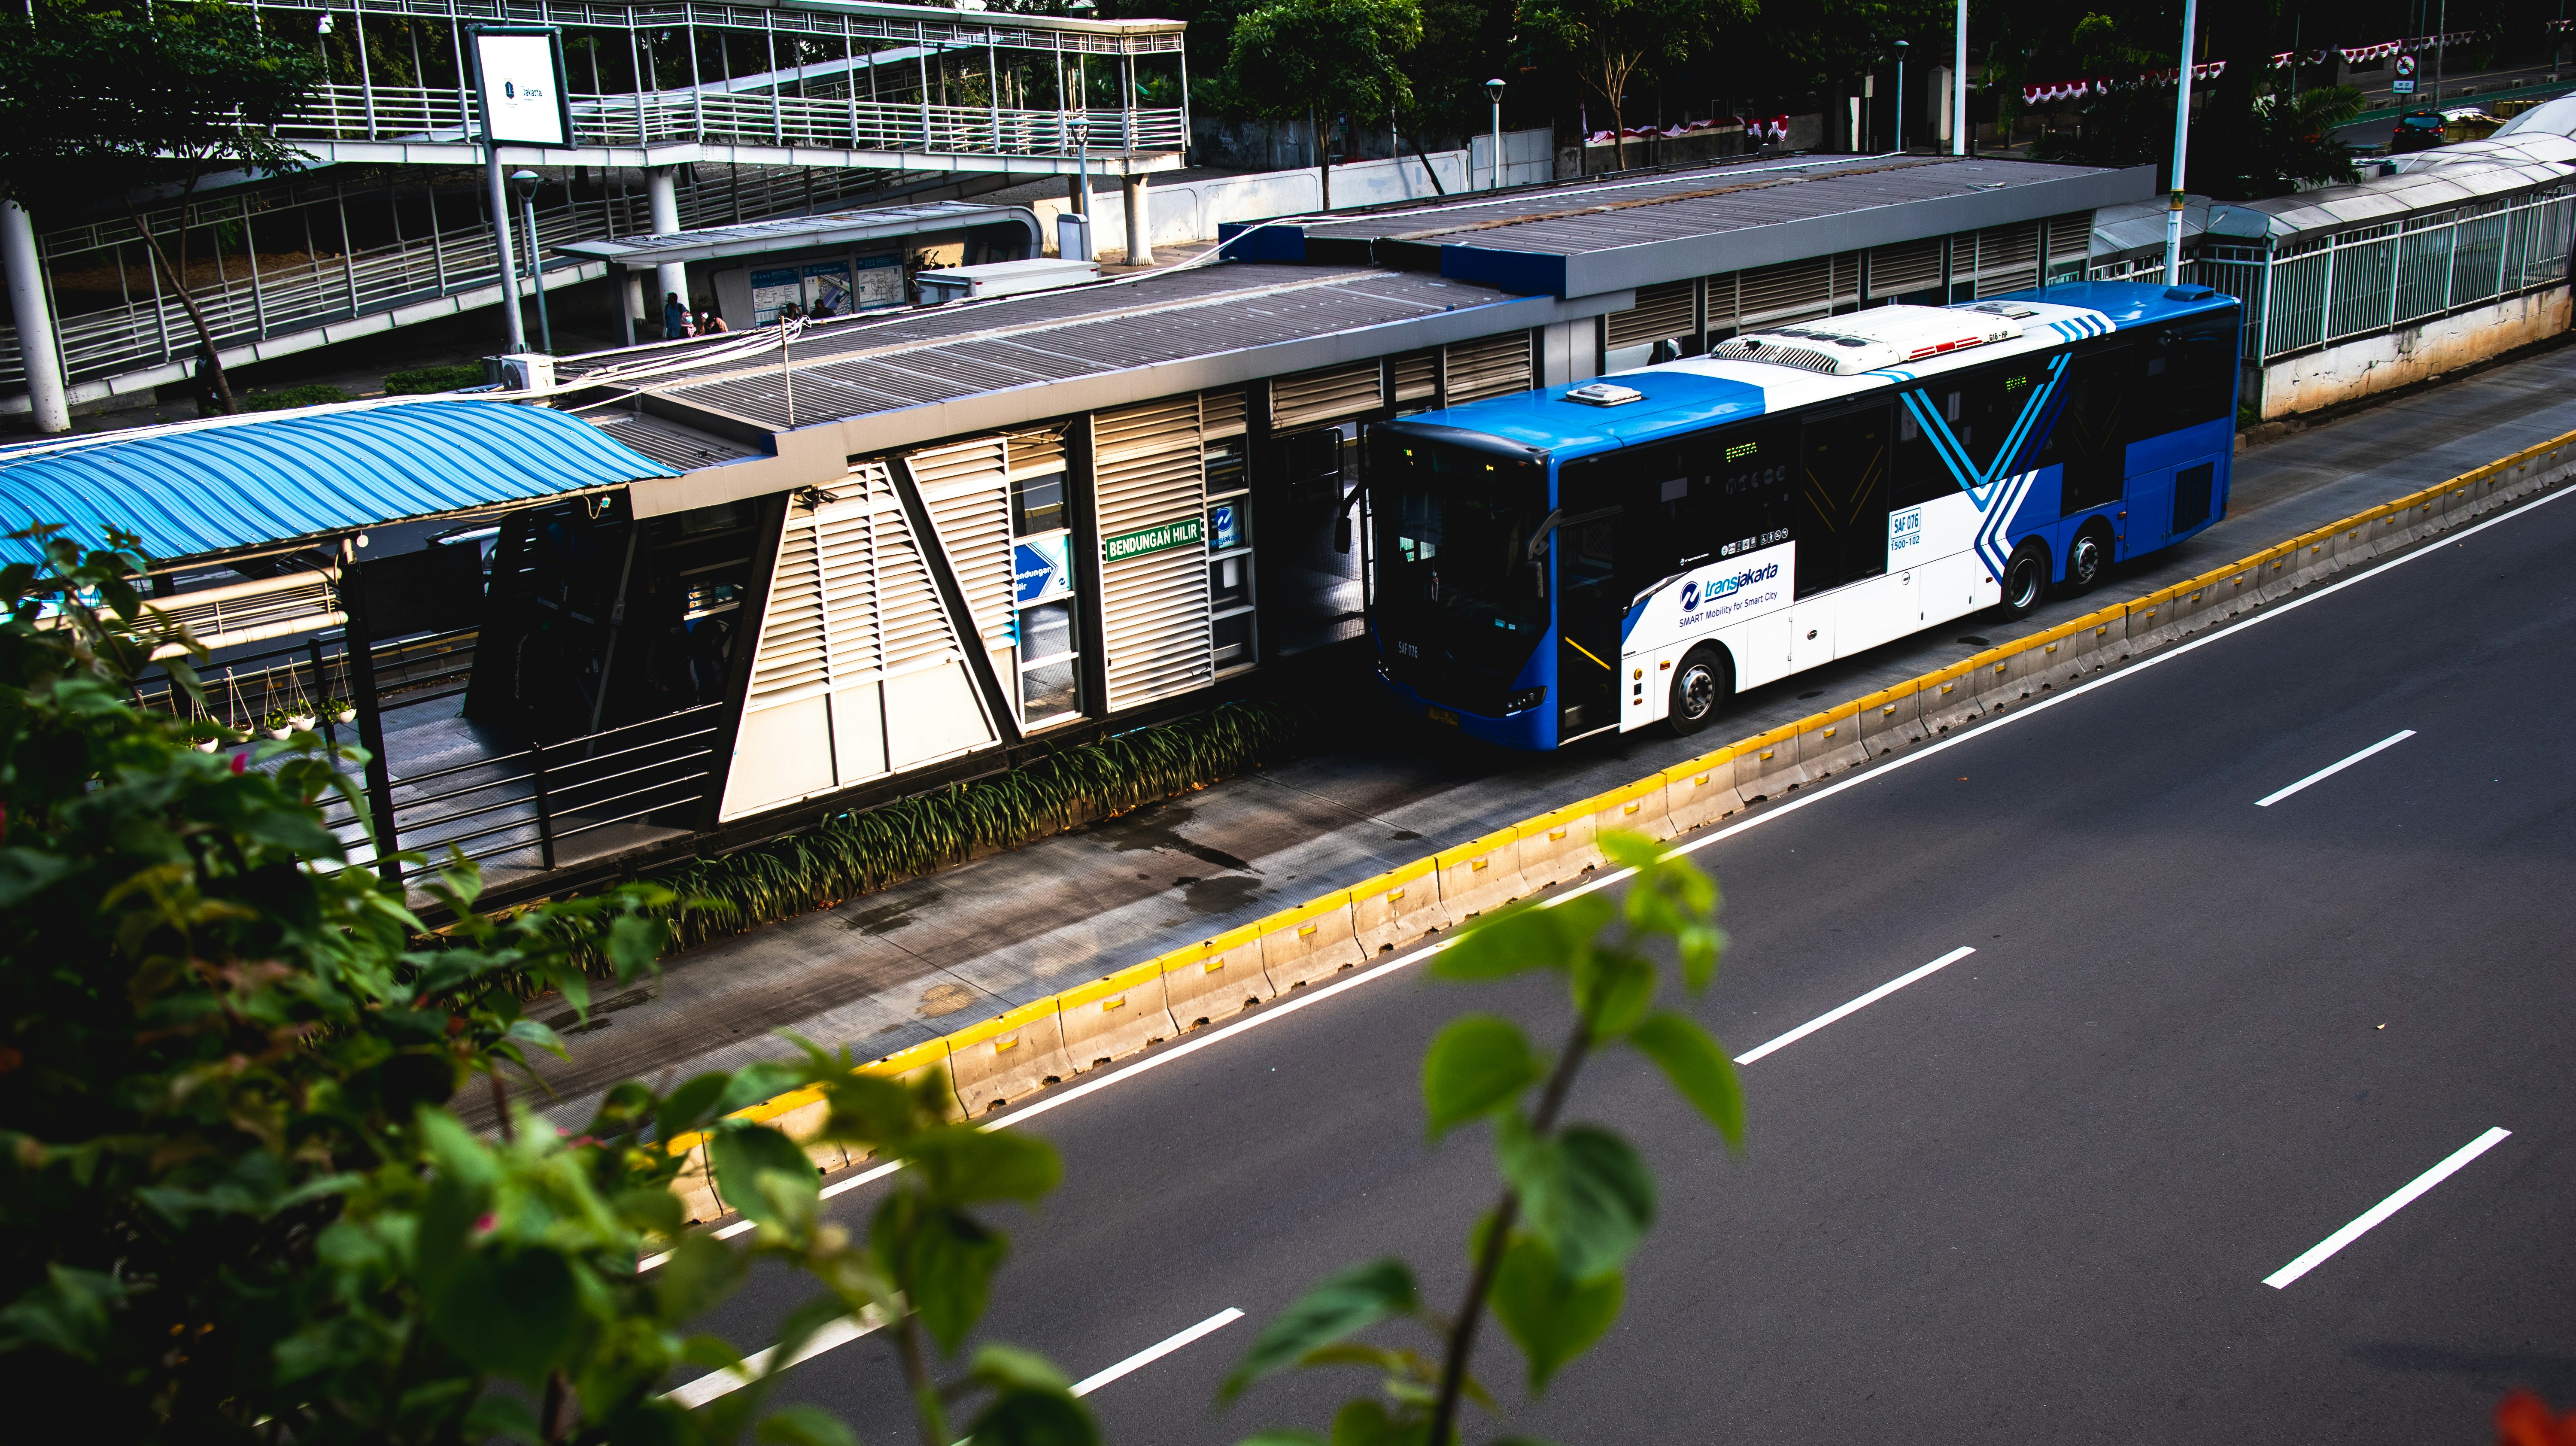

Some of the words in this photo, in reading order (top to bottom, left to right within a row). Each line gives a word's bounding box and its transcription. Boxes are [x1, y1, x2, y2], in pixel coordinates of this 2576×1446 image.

[1989, 333, 1998, 341] G16
[1894, 516, 1906, 534] SAF
[1907, 513, 1919, 530] 076
[1109, 529, 1171, 557] BENDUNGAN
[1173, 523, 1197, 543] HILIR
[1891, 535, 1920, 551] 1500-102
[1016, 566, 1052, 580] endungan
[1016, 583, 1027, 592] ilir
[1704, 563, 1778, 603] transjakarta
[1679, 612, 1704, 628] SMART
[1705, 606, 1732, 620] Mobility
[1734, 601, 1743, 611] for
[1744, 595, 1763, 608] Smart
[1765, 591, 1777, 601] City
[1399, 641, 1407, 655] SAF
[1408, 644, 1418, 659] 076
